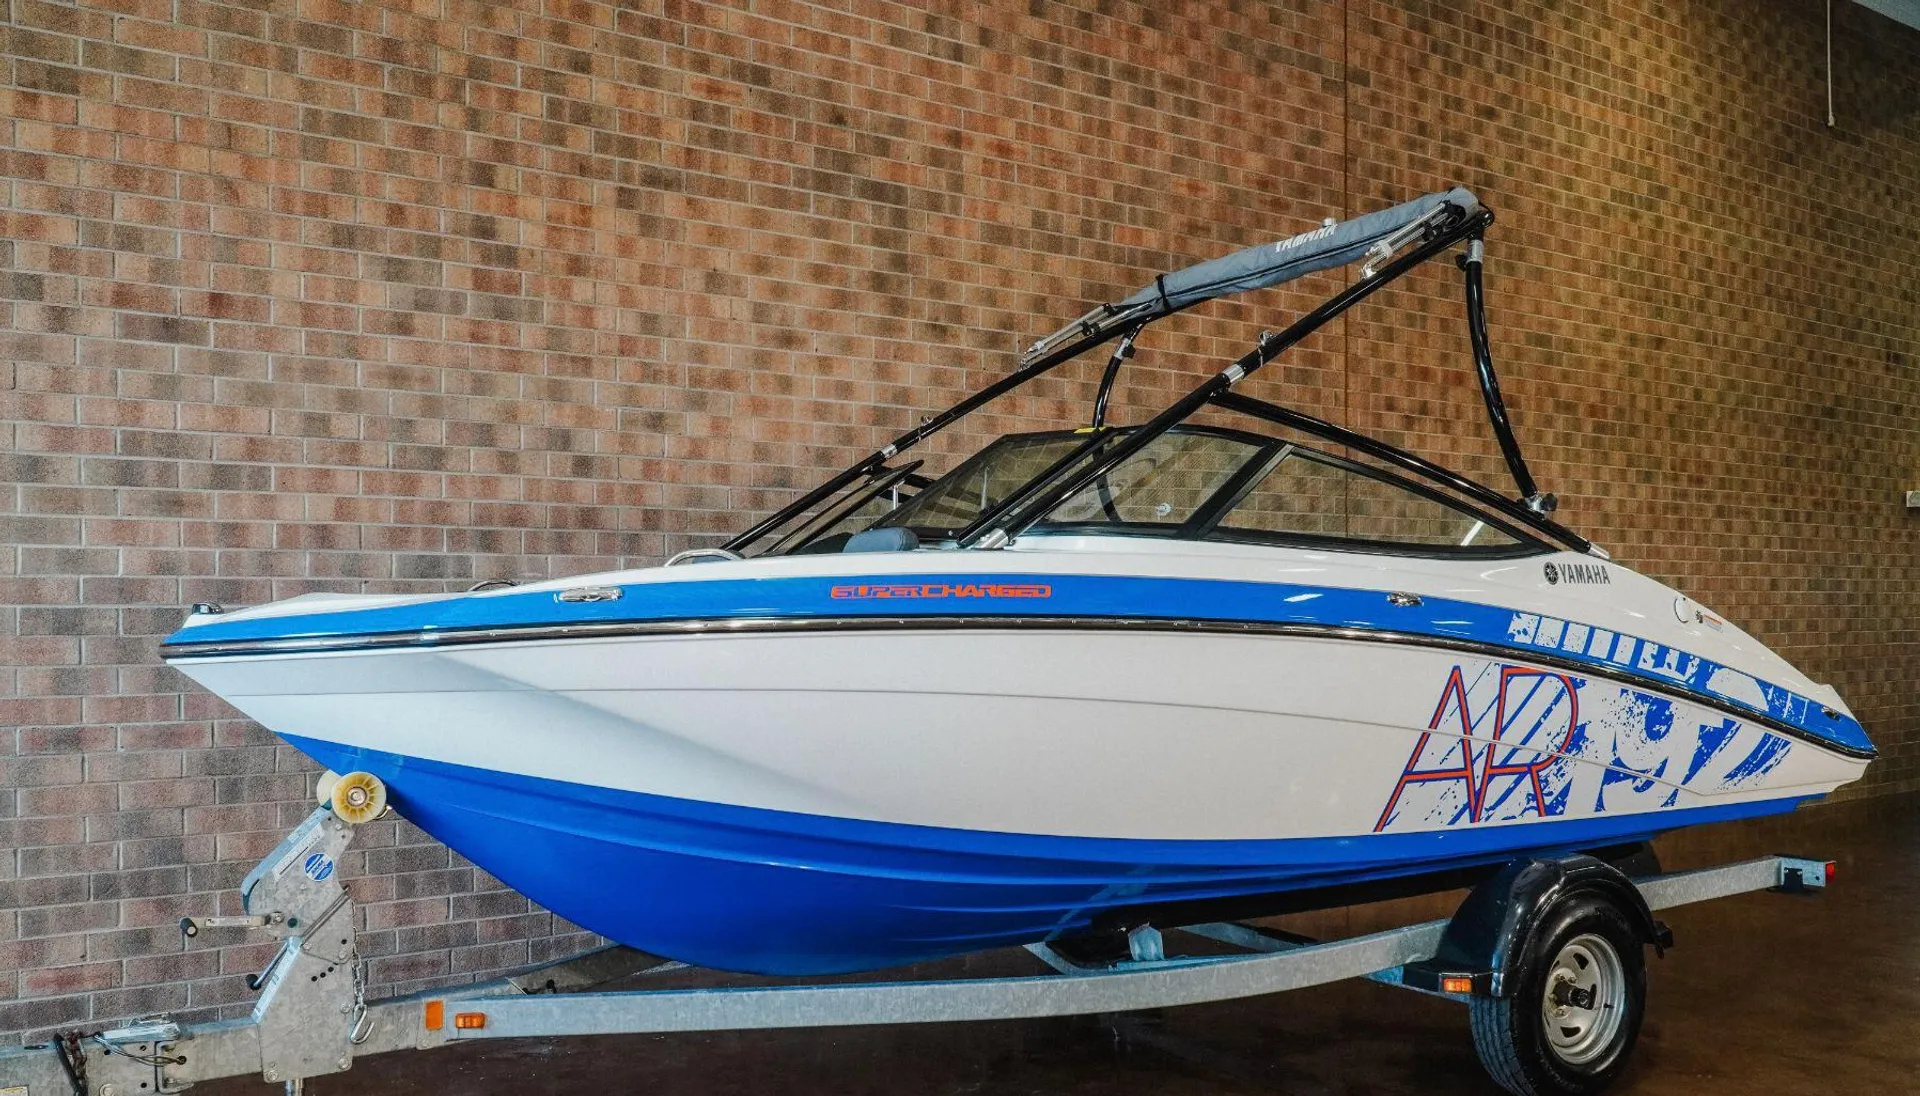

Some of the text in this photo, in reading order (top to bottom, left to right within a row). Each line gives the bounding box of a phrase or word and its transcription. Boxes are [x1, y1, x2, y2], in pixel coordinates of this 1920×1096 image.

[1558, 563, 1611, 584] YAMAHA
[831, 584, 1052, 599] SUPERCHARGED
[1373, 664, 1579, 832] AR
